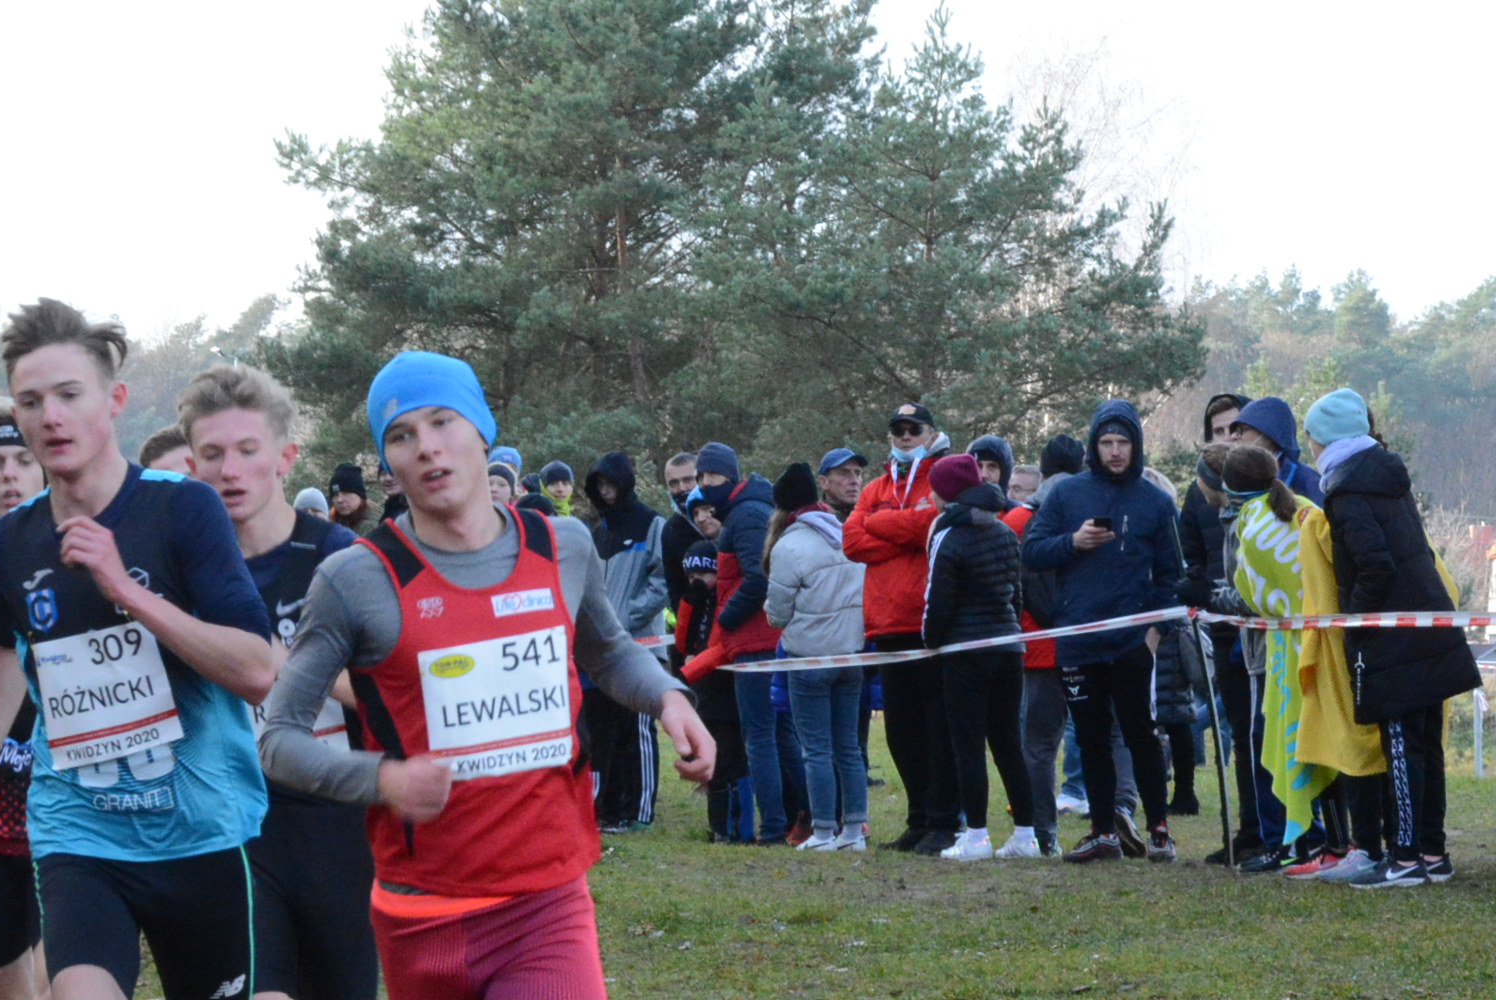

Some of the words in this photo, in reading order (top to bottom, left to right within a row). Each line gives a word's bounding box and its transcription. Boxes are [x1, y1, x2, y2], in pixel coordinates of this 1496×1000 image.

[88, 628, 143, 666] 309
[502, 633, 561, 672] 541
[48, 674, 155, 719] RÓŻNICKI
[441, 683, 567, 729] LEWALSKI
[65, 740, 122, 761] KWIDZYN
[125, 728, 160, 749] 2020
[455, 750, 527, 773] KWIDZYN
[531, 742, 567, 761] 2020
[93, 788, 162, 811] GRANIT
